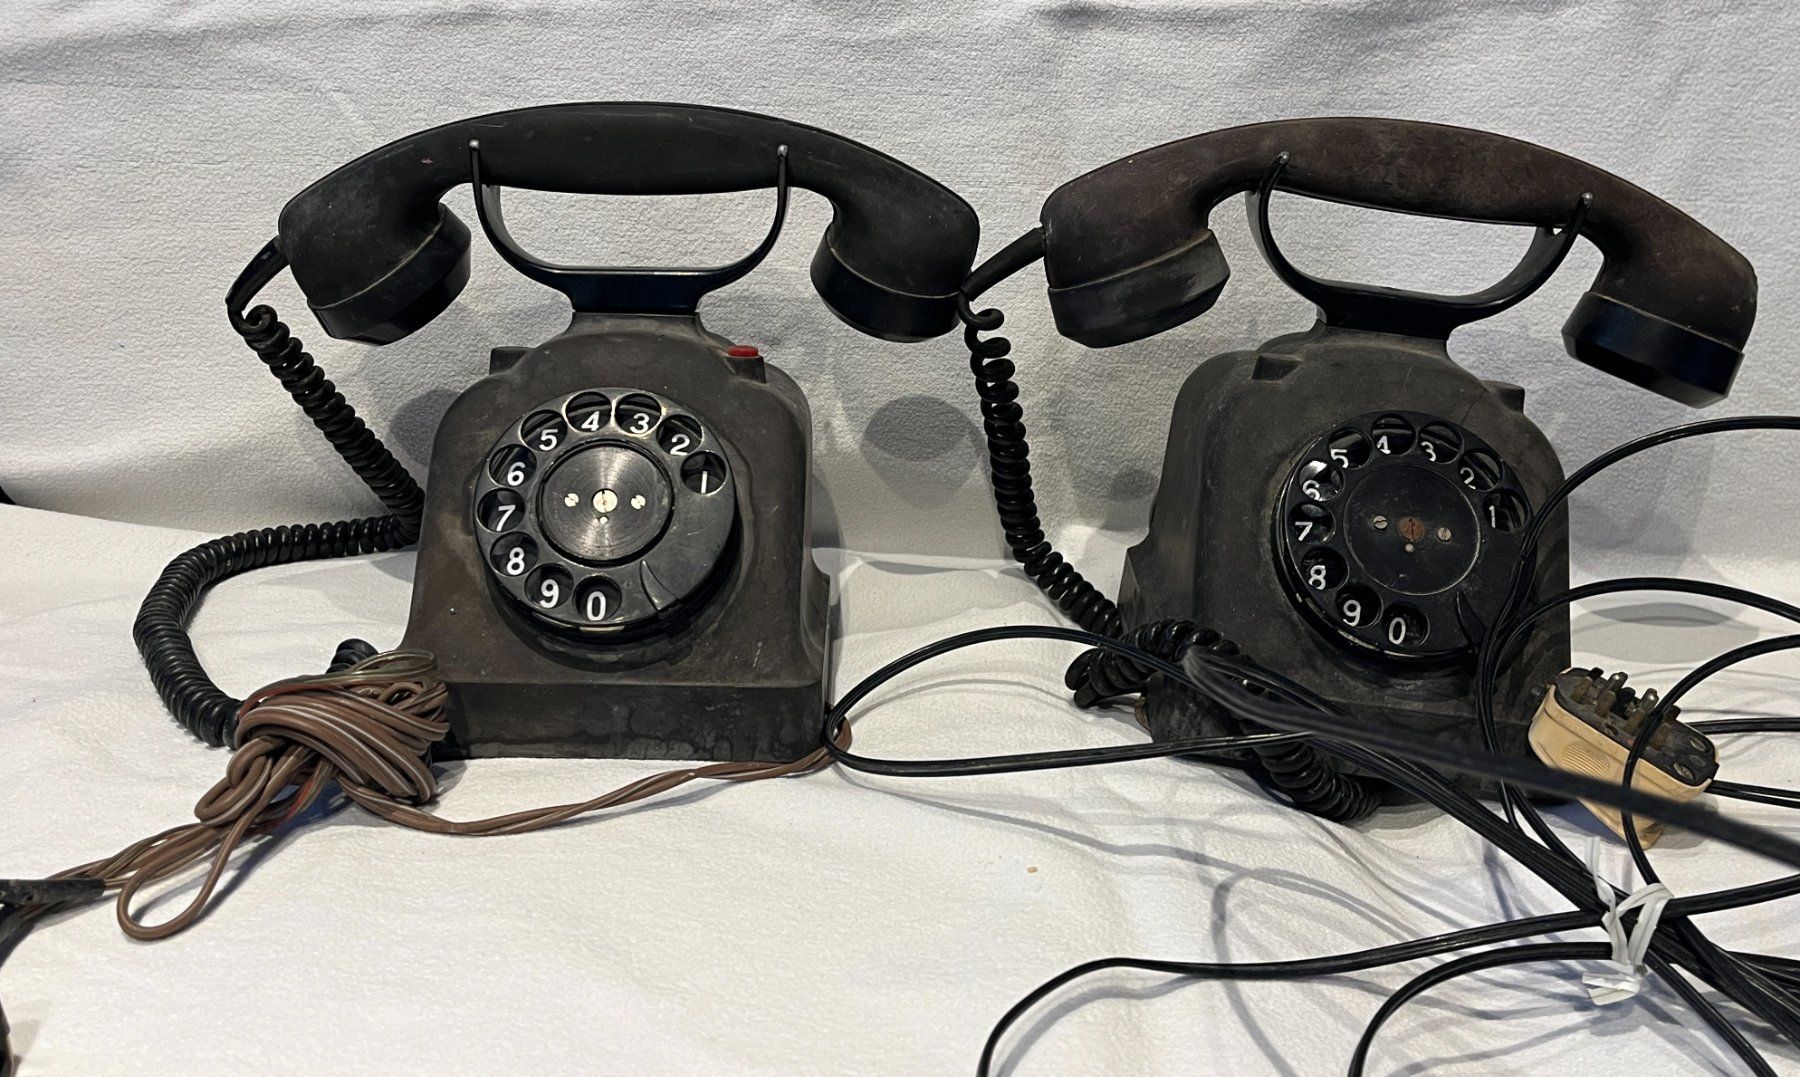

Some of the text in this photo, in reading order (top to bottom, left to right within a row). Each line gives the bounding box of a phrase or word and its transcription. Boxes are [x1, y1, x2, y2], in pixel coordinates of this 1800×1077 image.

[581, 411, 600, 432] 4
[629, 412, 649, 433] 3
[539, 429, 558, 451] 5
[669, 433, 691, 456] 2
[1376, 435, 1391, 455] 4
[1420, 441, 1436, 462] 3
[1330, 449, 1349, 469] 5
[507, 462, 526, 486] 6
[701, 471, 708, 494] 1
[1459, 467, 1476, 490] 2
[1302, 479, 1321, 501] 6
[496, 504, 516, 532] 7
[1488, 505, 1496, 528] 1
[1295, 521, 1313, 541] 7
[506, 547, 525, 575] 8
[1308, 564, 1326, 591] 8
[539, 579, 559, 609] 9
[586, 591, 606, 621] 0
[1342, 599, 1361, 627] 9
[1388, 617, 1406, 645] 0
